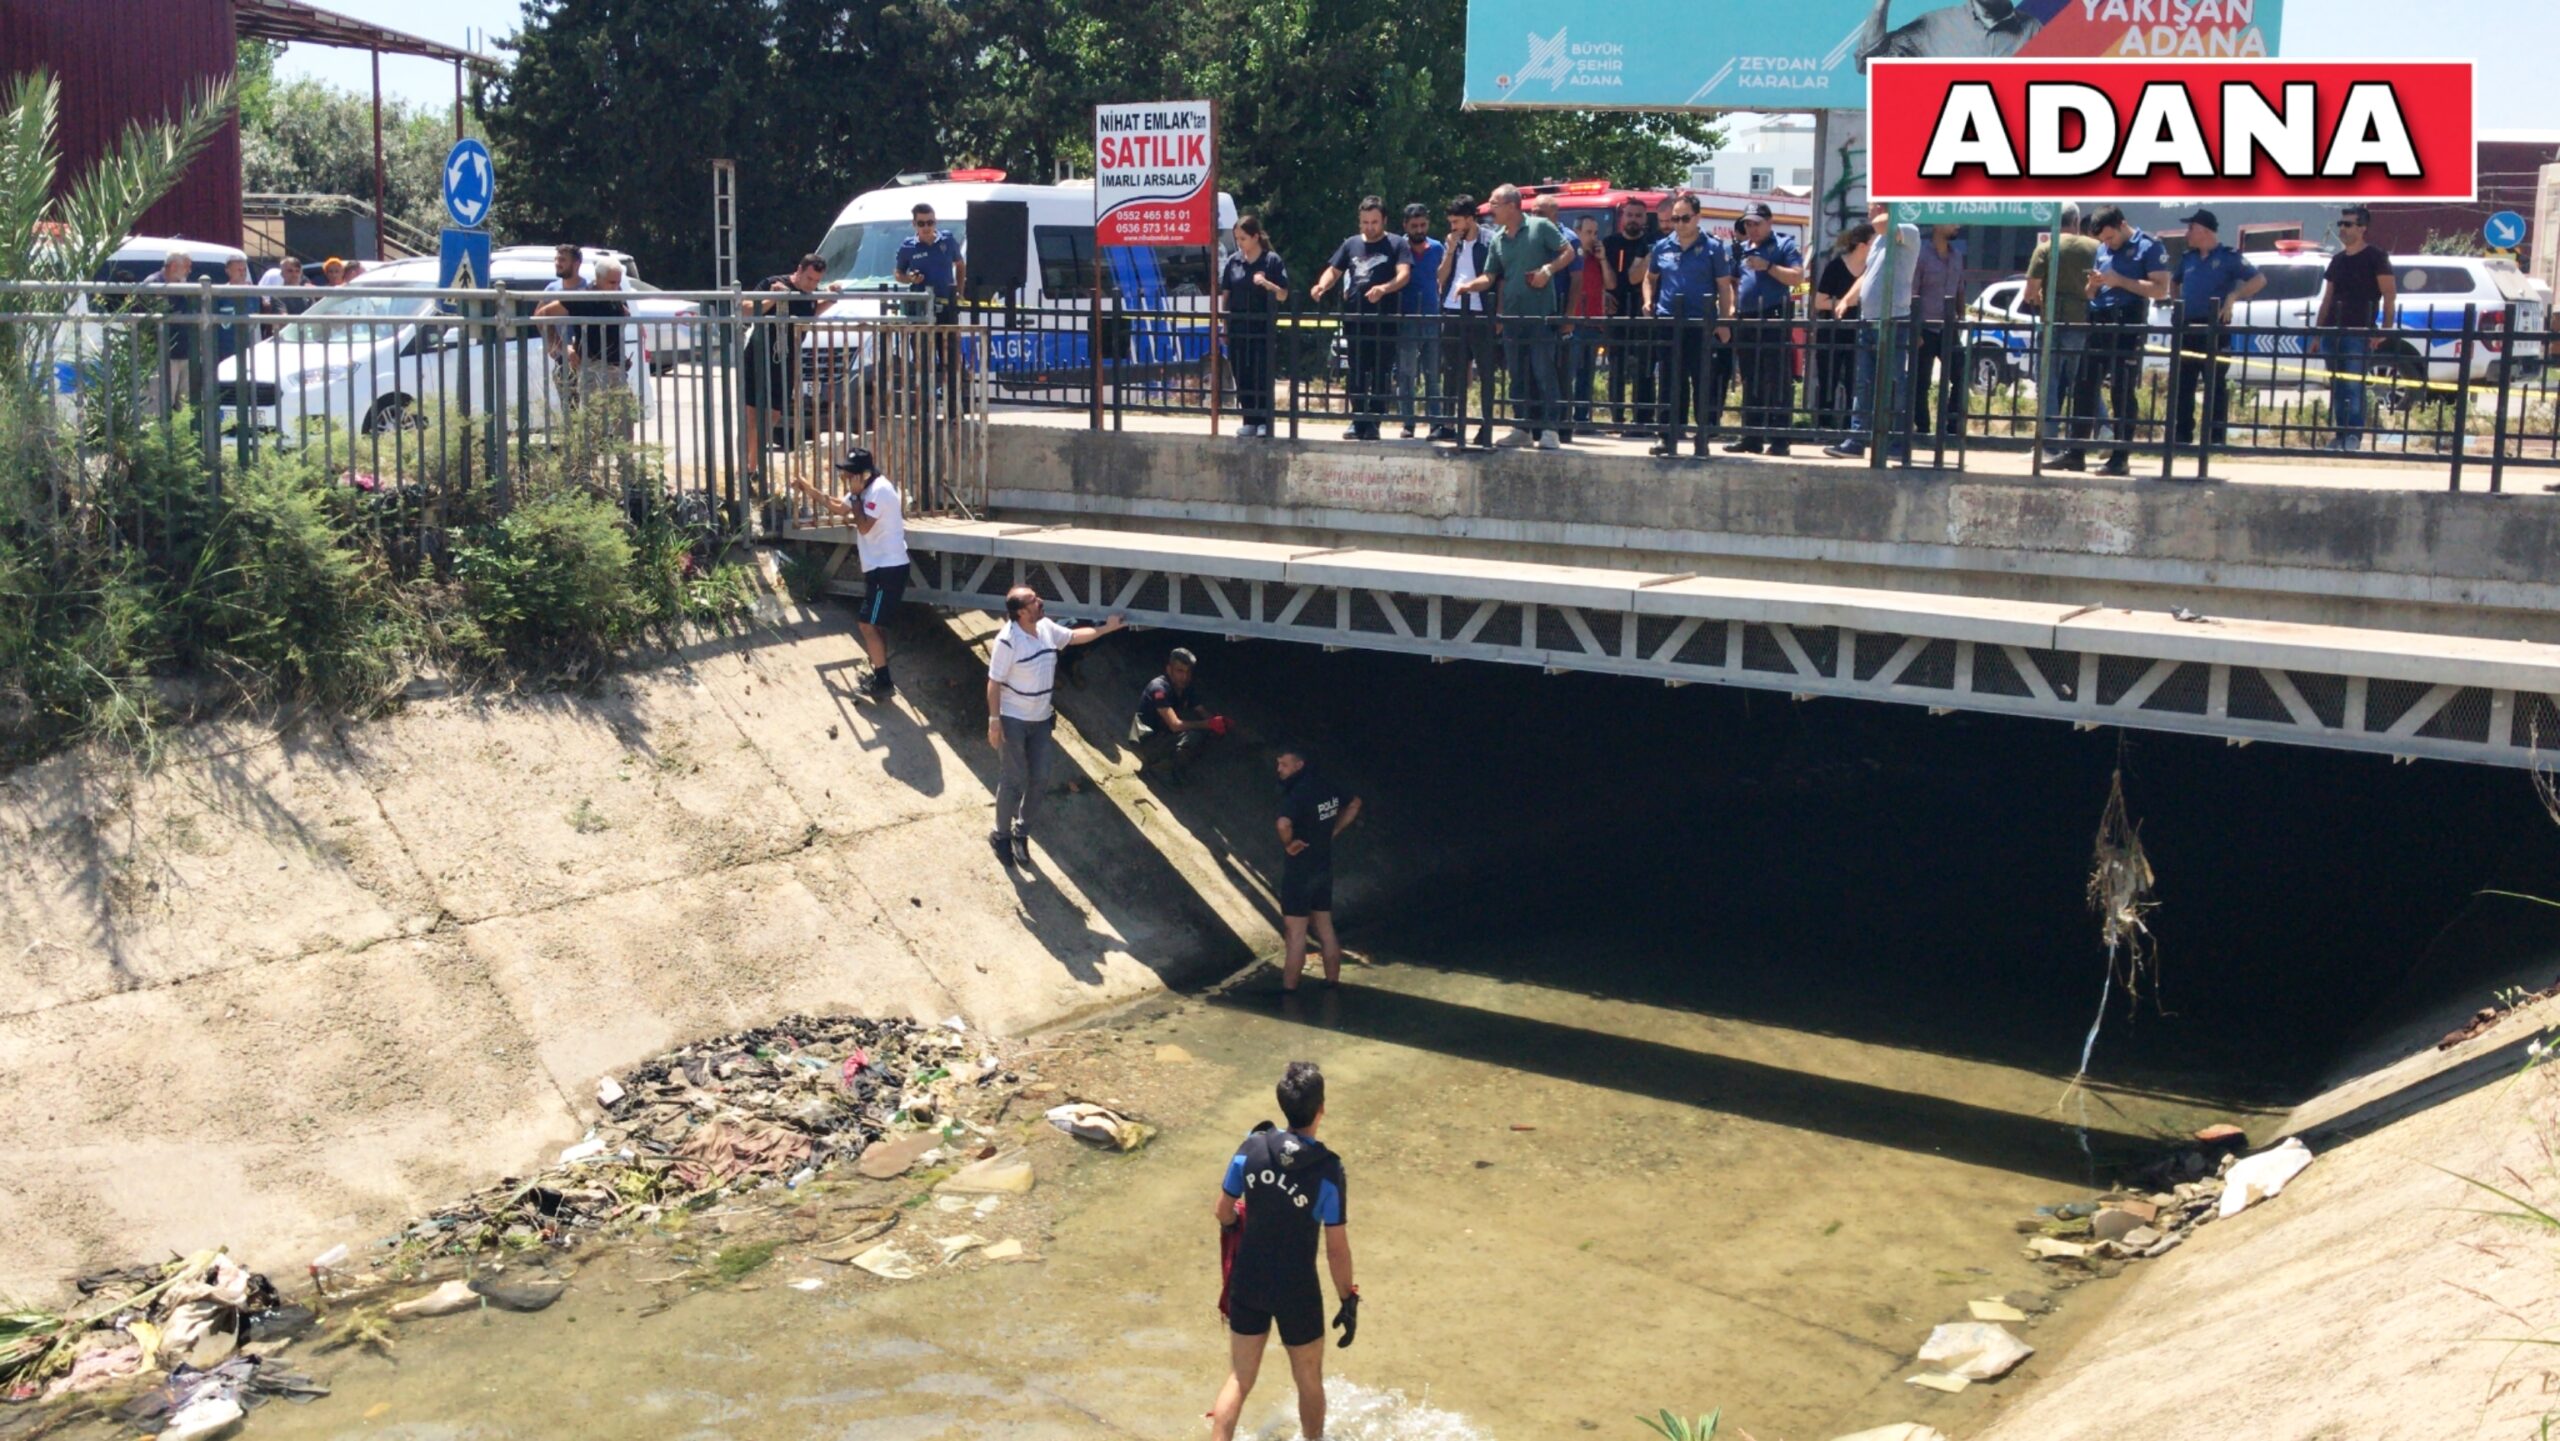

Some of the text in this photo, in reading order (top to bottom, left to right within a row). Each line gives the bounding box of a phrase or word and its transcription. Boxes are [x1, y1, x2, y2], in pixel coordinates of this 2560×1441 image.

[2119, 24, 2268, 57] ADANA
[1571, 42, 1623, 55] BÜYÜK
[1577, 59, 1623, 73] ŞEHİR
[1739, 56, 1817, 71] ZEYDAN
[1569, 74, 1623, 86] ADANA
[1738, 74, 1830, 89] KARALAR
[1100, 110, 1140, 132] NİHAT
[1100, 134, 1206, 169] SATILIK
[1101, 172, 1197, 187] İMARLI ARSALAR
[1926, 201, 1945, 214] VE
[1116, 210, 1191, 220] 0552 465 85 01
[1116, 222, 1191, 233] 0536 573 14 42
